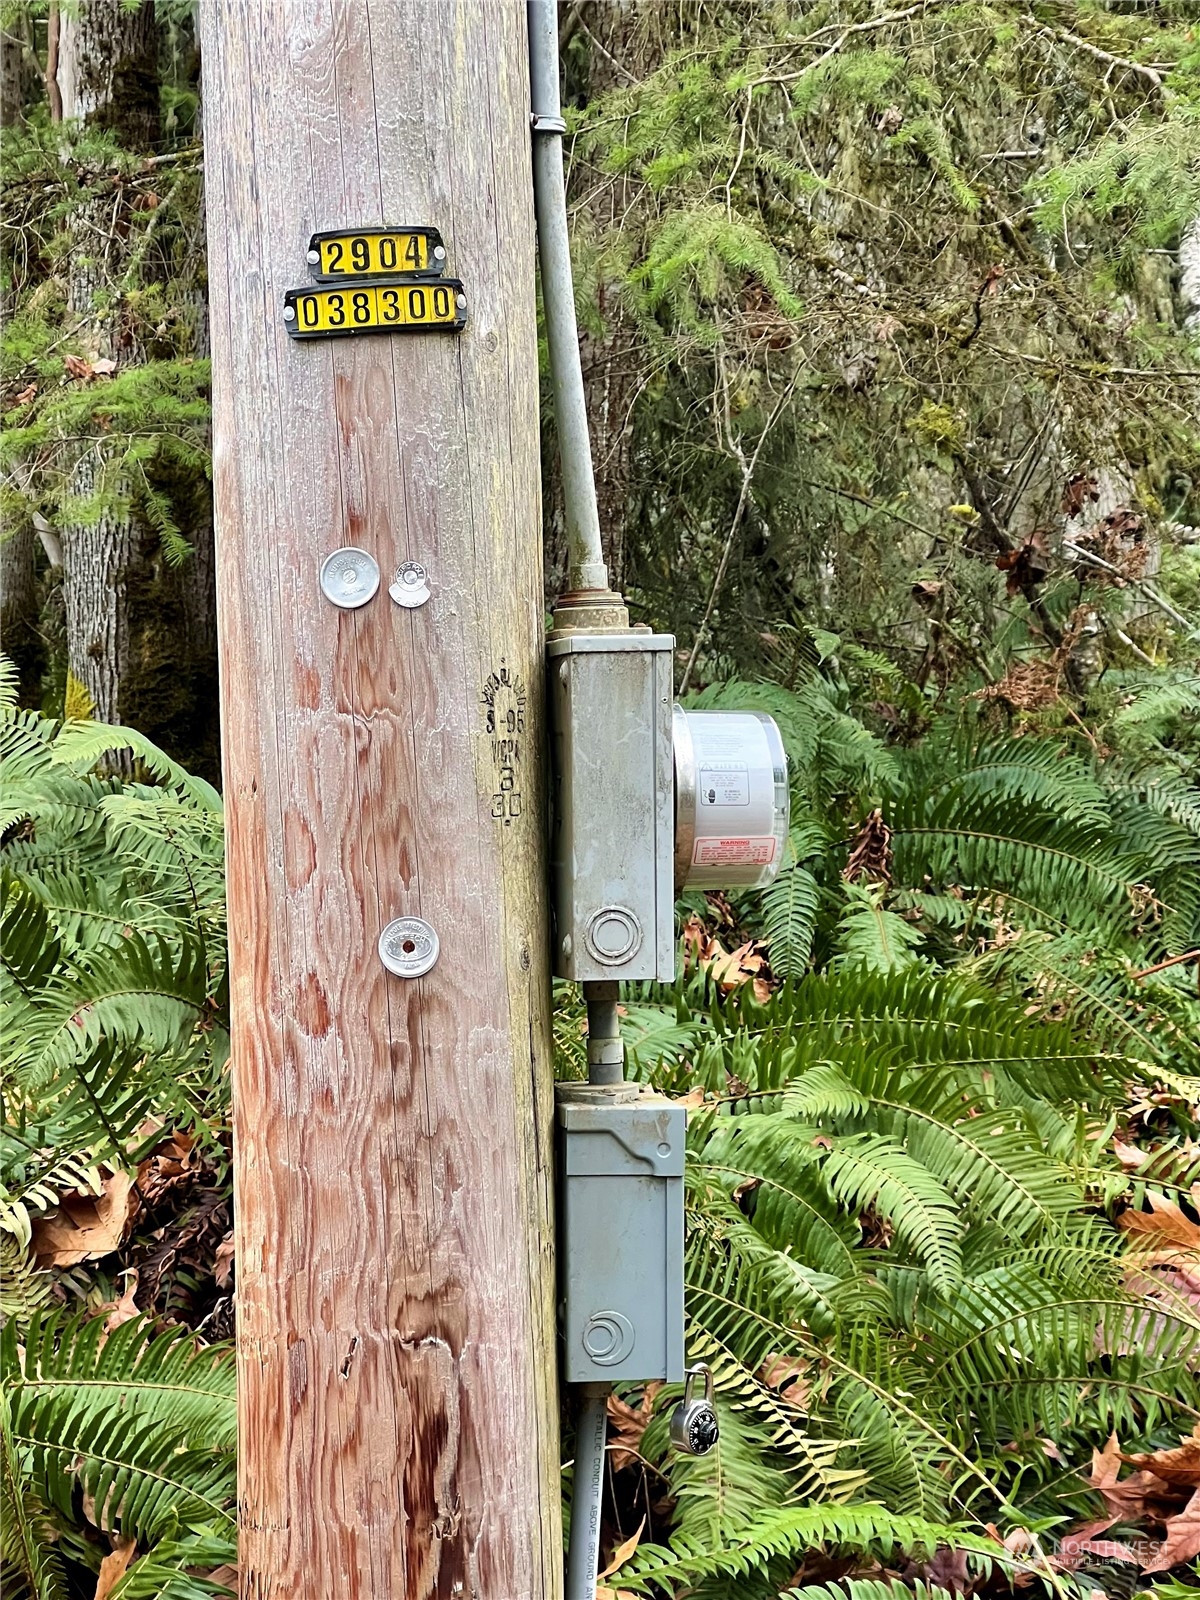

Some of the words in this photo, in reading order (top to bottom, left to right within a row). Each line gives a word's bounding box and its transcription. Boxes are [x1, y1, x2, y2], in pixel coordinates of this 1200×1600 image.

[327, 235, 424, 273] 2904
[303, 287, 450, 327] 038300
[591, 1457, 600, 1498] CONDUIT
[589, 1505, 598, 1536] ABOVE
[586, 1541, 595, 1581] GROUND
